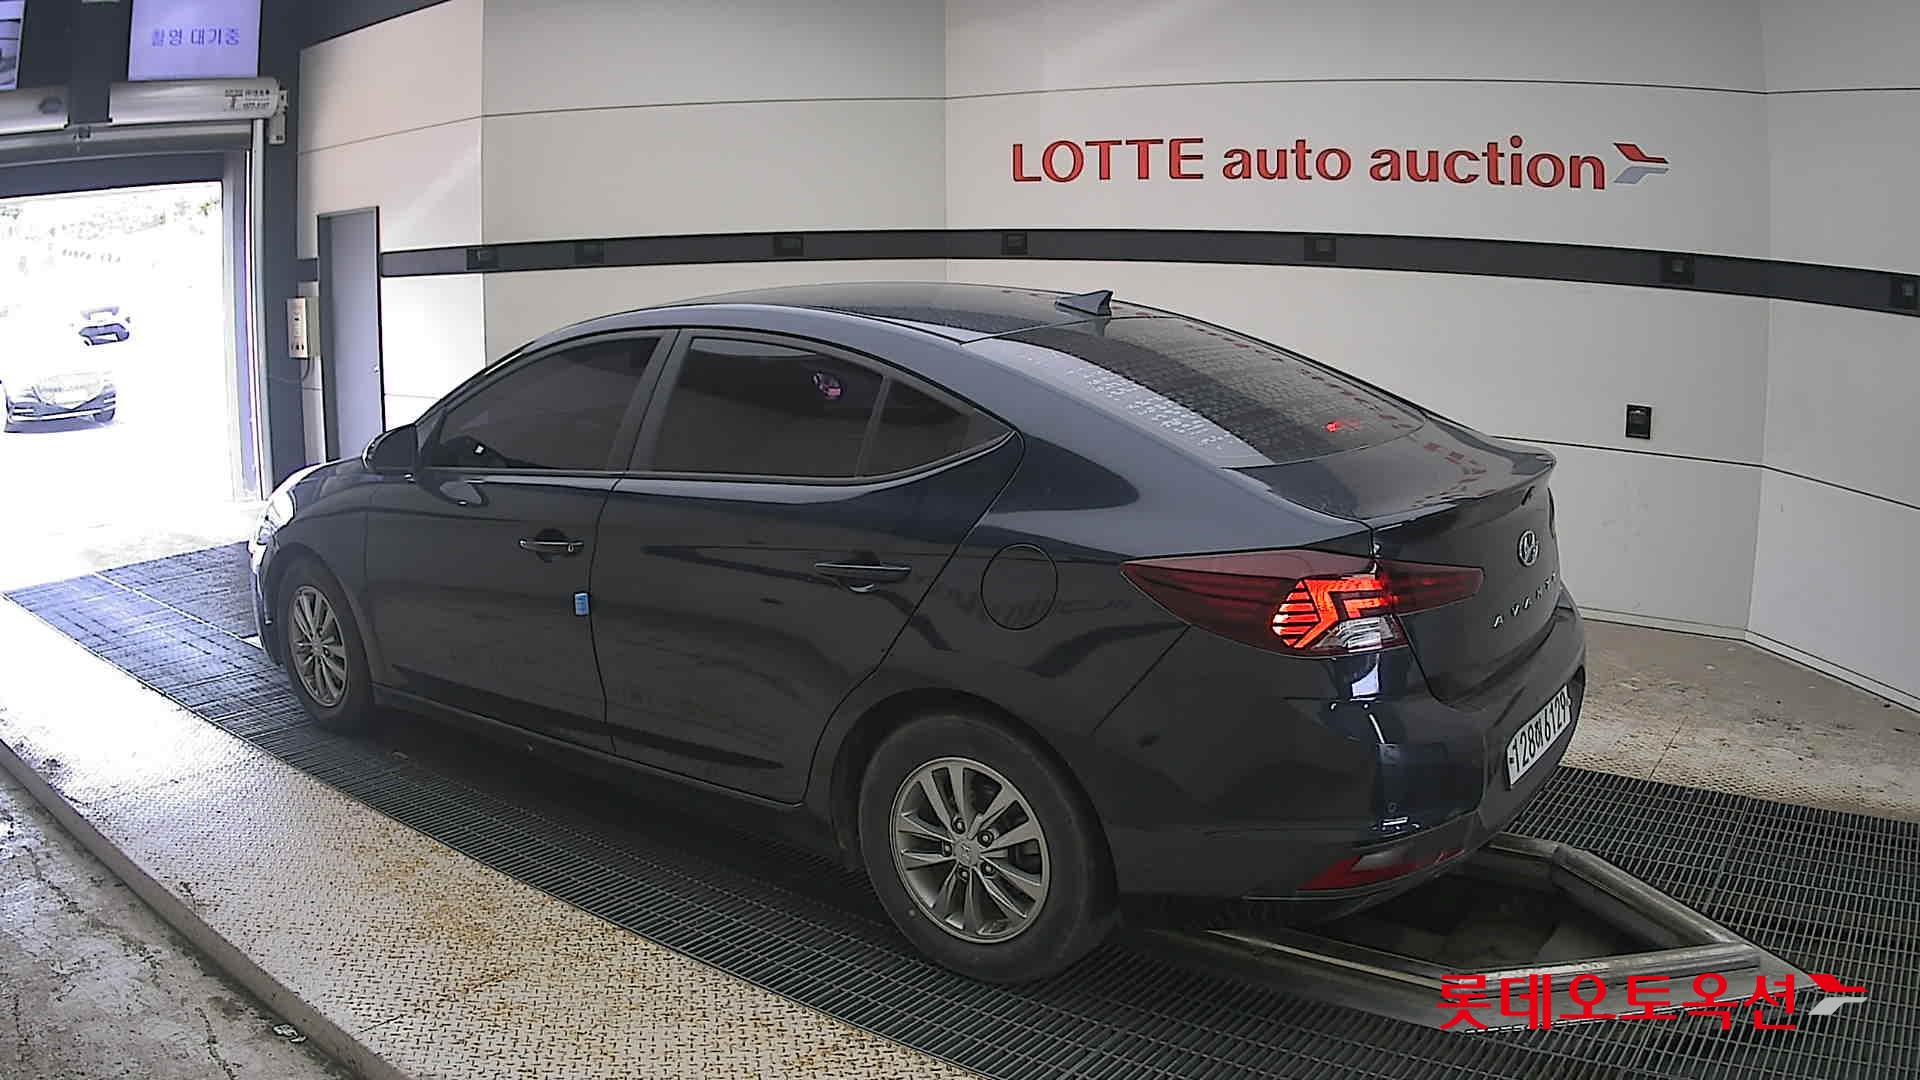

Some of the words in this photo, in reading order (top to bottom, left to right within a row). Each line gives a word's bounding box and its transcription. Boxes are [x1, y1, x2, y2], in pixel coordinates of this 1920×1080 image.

[190, 27, 240, 46] 대기중
[1012, 137, 1204, 183] LOTTE
[1222, 139, 1352, 181] auto
[1368, 135, 1606, 190] auction
